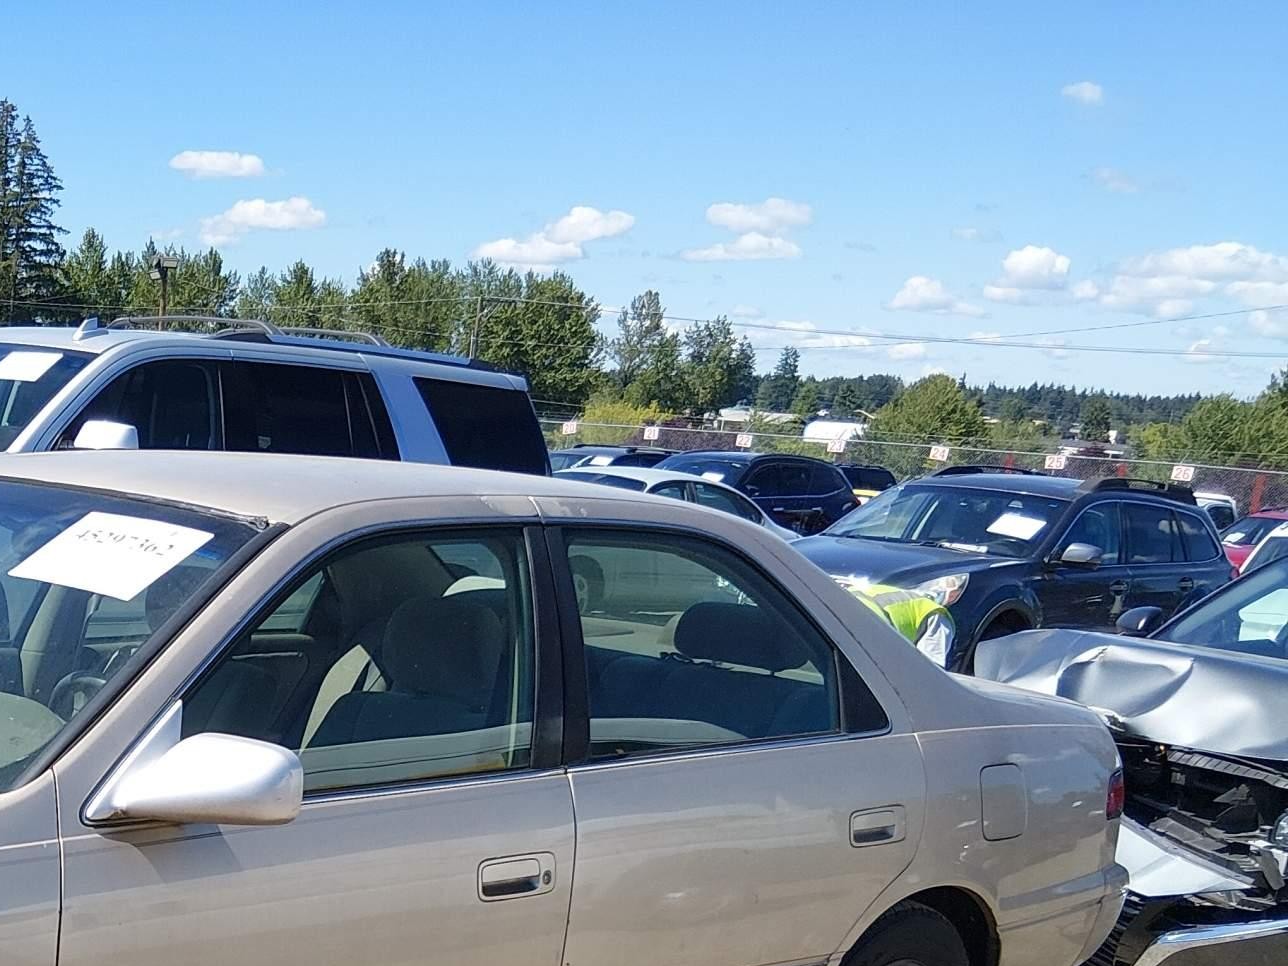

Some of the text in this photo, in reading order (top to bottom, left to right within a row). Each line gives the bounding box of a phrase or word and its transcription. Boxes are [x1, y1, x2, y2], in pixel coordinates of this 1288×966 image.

[647, 429, 656, 439] 21
[738, 435, 750, 446] 22
[931, 448, 945, 459] 24
[1047, 456, 1062, 469] 25
[1174, 467, 1190, 479] 26
